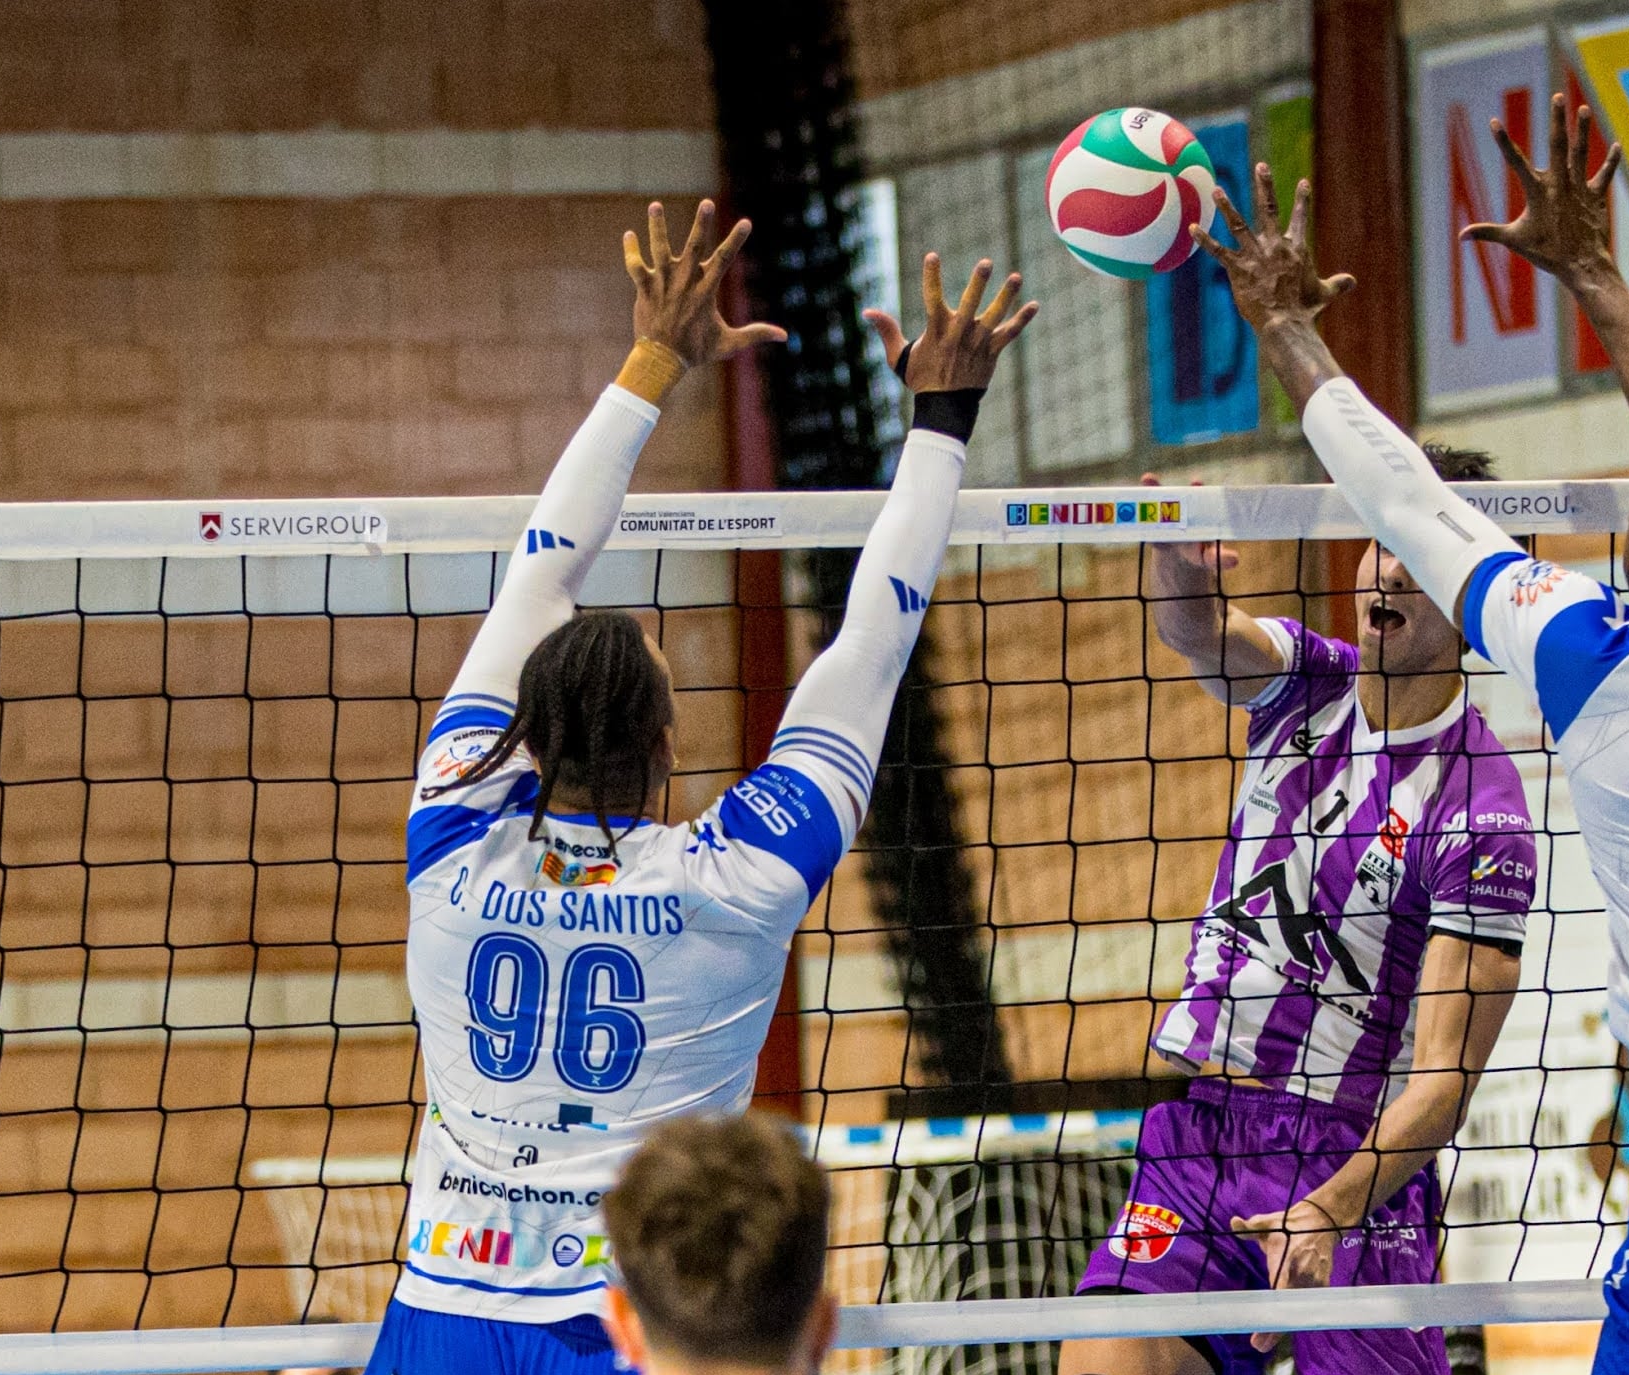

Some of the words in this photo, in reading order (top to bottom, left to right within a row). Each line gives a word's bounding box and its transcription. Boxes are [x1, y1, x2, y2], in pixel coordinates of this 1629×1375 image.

[230, 514, 382, 538] SERVIGROUP
[621, 518, 696, 532] COMUNITAT
[698, 518, 715, 531] DE
[717, 517, 776, 531] L'ESPORT
[1007, 501, 1182, 526] BENIDORM
[1314, 789, 1350, 834] 1
[449, 865, 467, 912] C.
[481, 880, 547, 928] DOS
[558, 890, 685, 936] SANTOS
[466, 932, 647, 1093] 96
